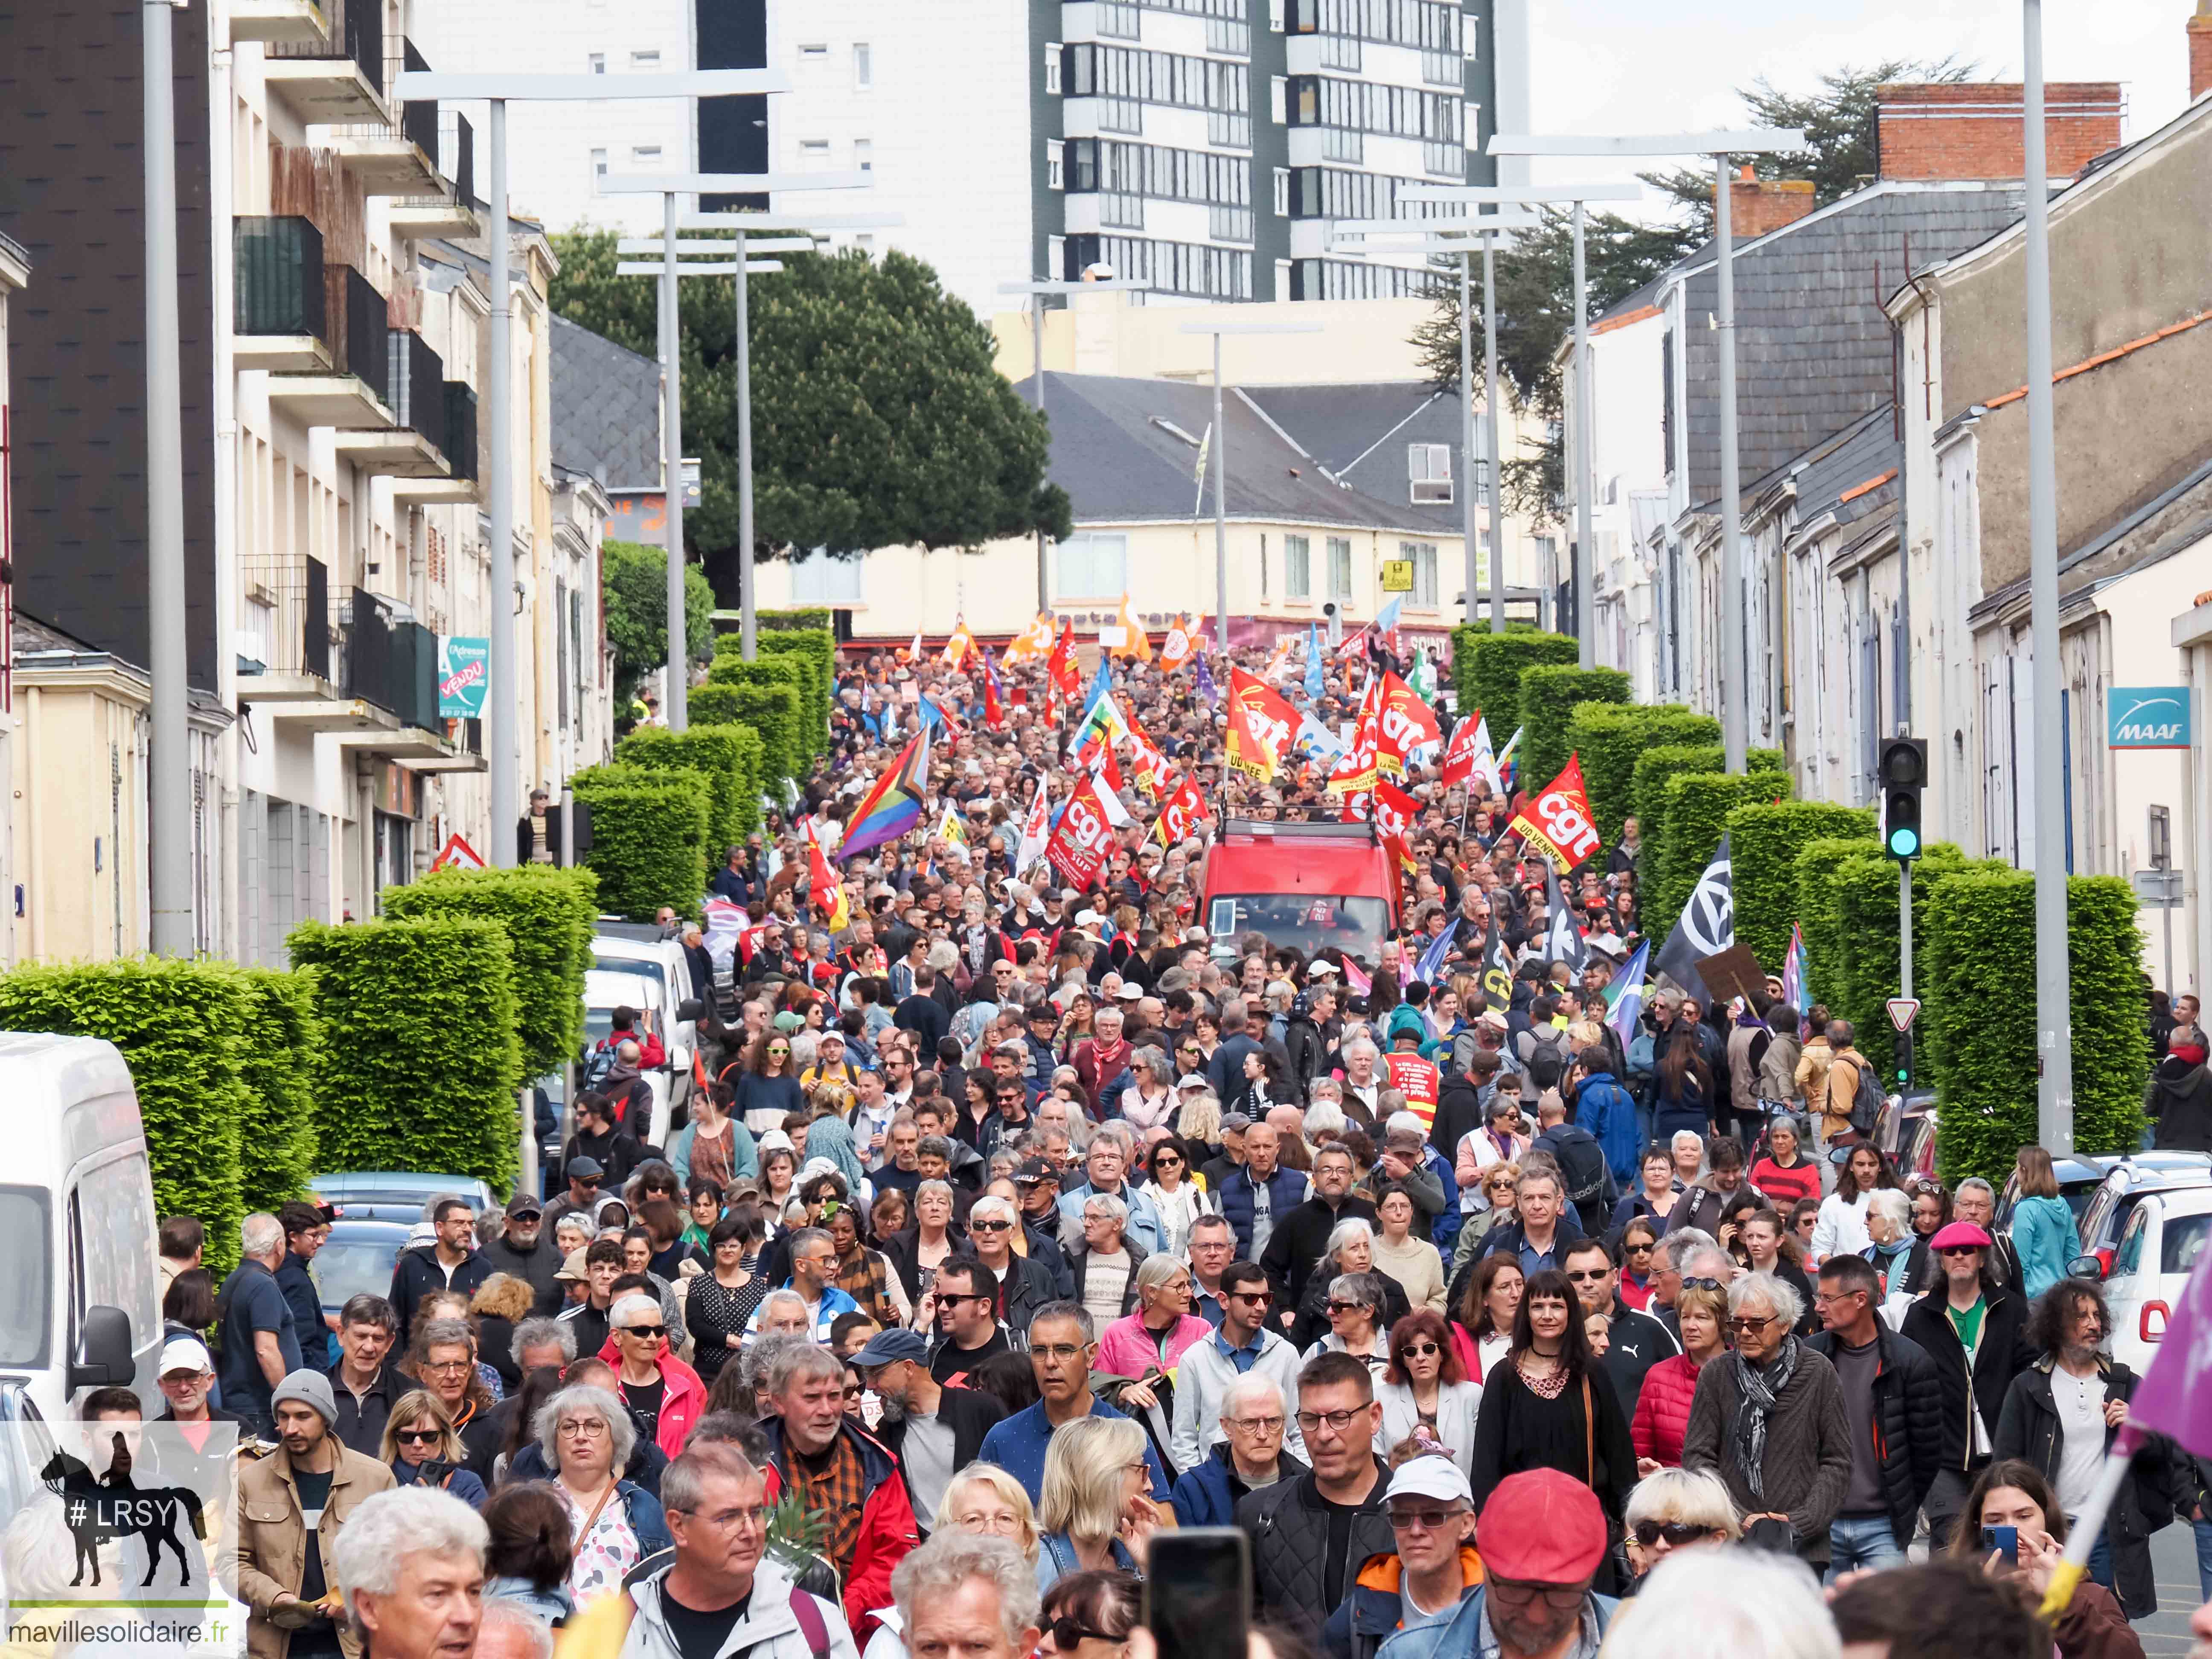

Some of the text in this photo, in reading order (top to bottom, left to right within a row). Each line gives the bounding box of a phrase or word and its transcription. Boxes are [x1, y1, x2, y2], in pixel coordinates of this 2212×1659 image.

[442, 661, 482, 695] VENDU
[2116, 724, 2183, 740] MAAF
[1230, 755, 1243, 767] UD
[1519, 824, 1533, 836] UD
[1538, 793, 1600, 858] cgt
[1071, 853, 1091, 871] SUP
